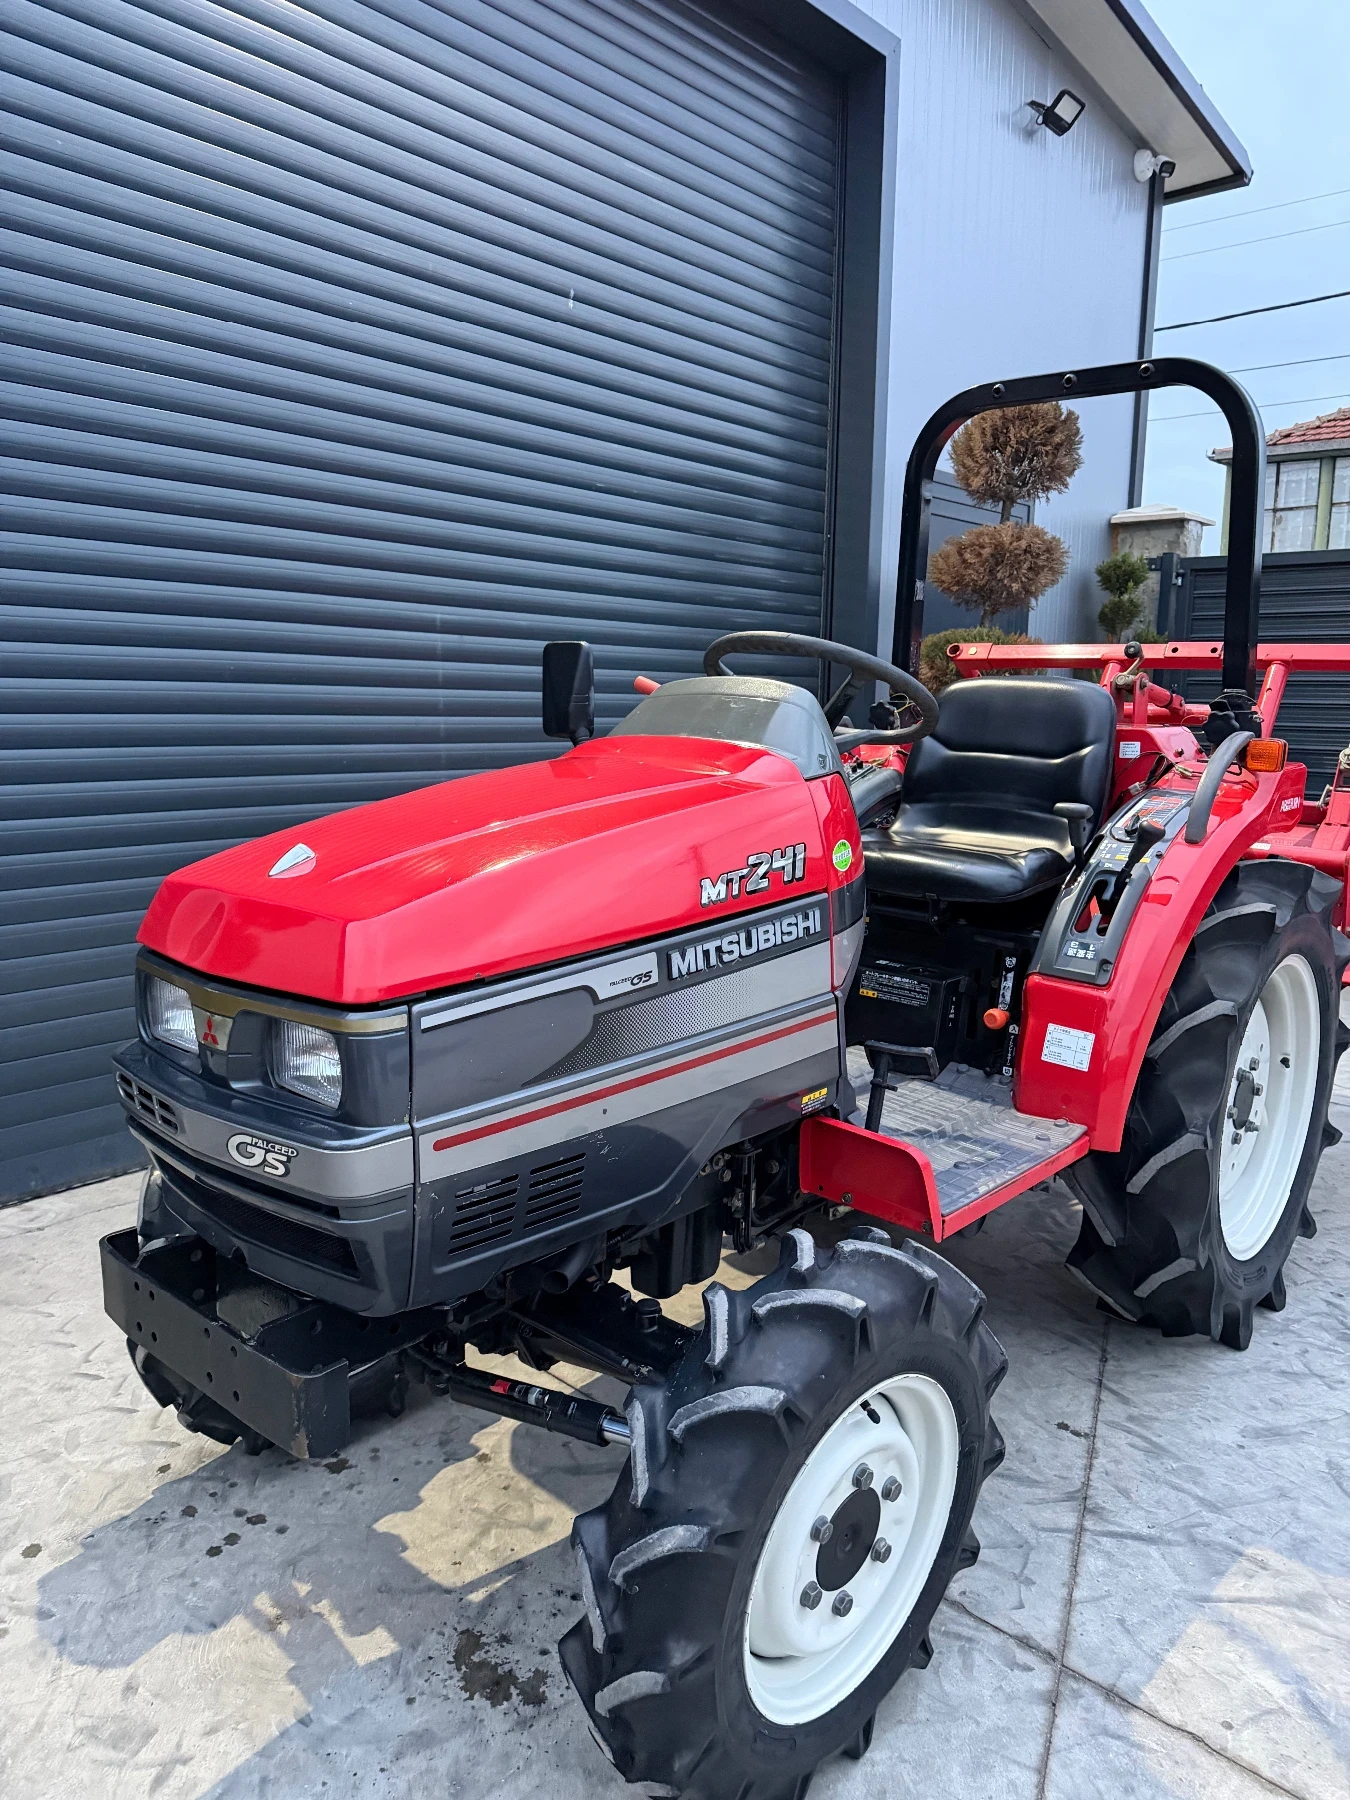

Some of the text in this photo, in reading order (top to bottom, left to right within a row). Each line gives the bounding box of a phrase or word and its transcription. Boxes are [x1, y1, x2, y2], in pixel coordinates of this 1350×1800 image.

[700, 842, 806, 907] MT241
[667, 907, 821, 981] MITSUBISHI
[630, 970, 653, 986] GS
[227, 1133, 289, 1177] GS
[252, 1137, 298, 1157] PALCEED
